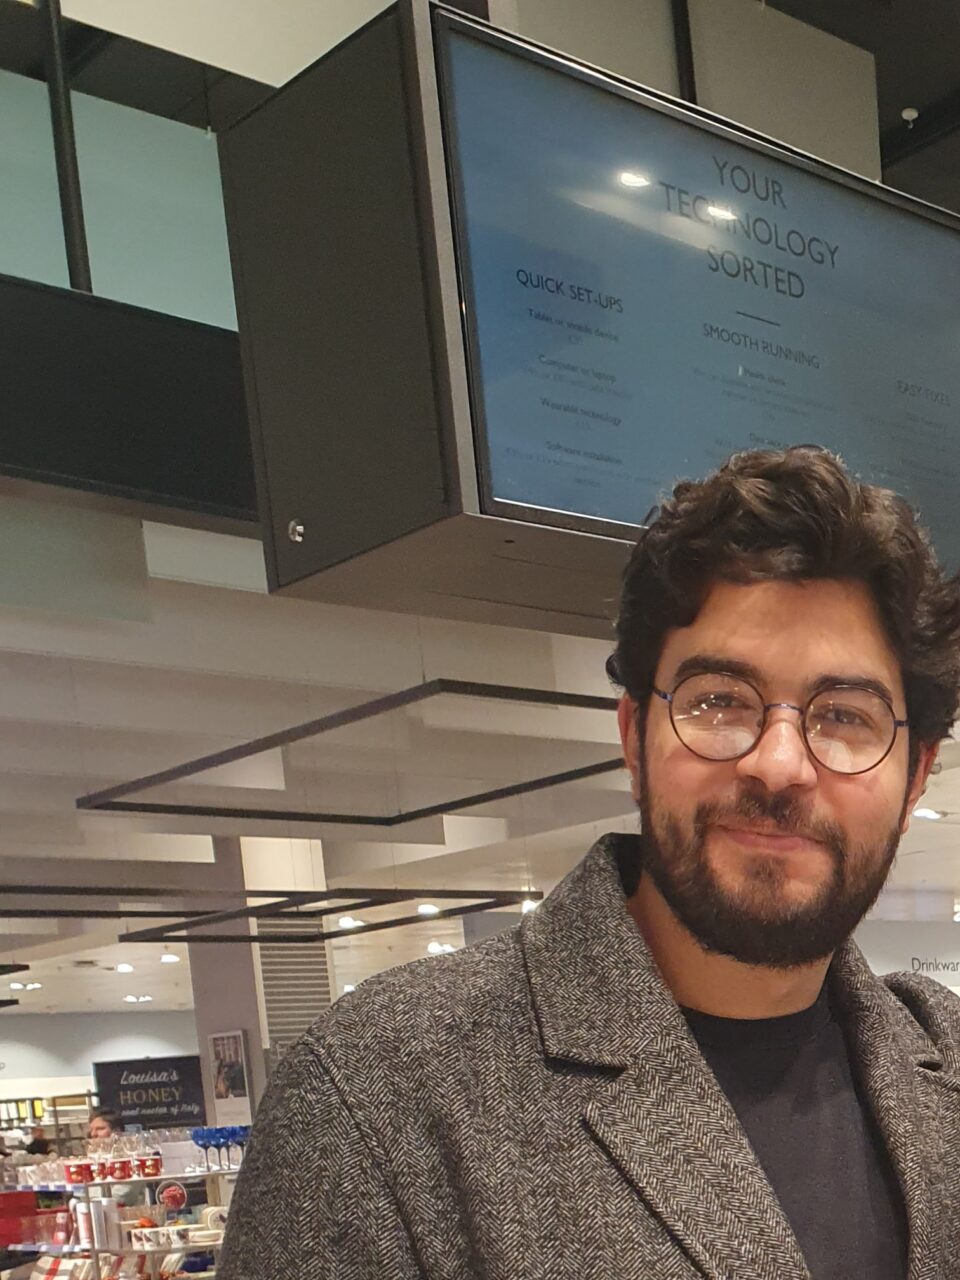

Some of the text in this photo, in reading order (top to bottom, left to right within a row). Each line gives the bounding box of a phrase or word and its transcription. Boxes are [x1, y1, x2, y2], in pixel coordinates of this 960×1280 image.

[712, 156, 787, 209] YOUR
[659, 181, 839, 270] TECNOLOGY
[516, 268, 624, 313] QUICK SET-UPS
[707, 246, 805, 299] SORTED
[702, 321, 820, 370] SMOOTH RUNNING
[120, 1070, 179, 1085] Louisa's
[120, 1086, 182, 1105] HONEY
